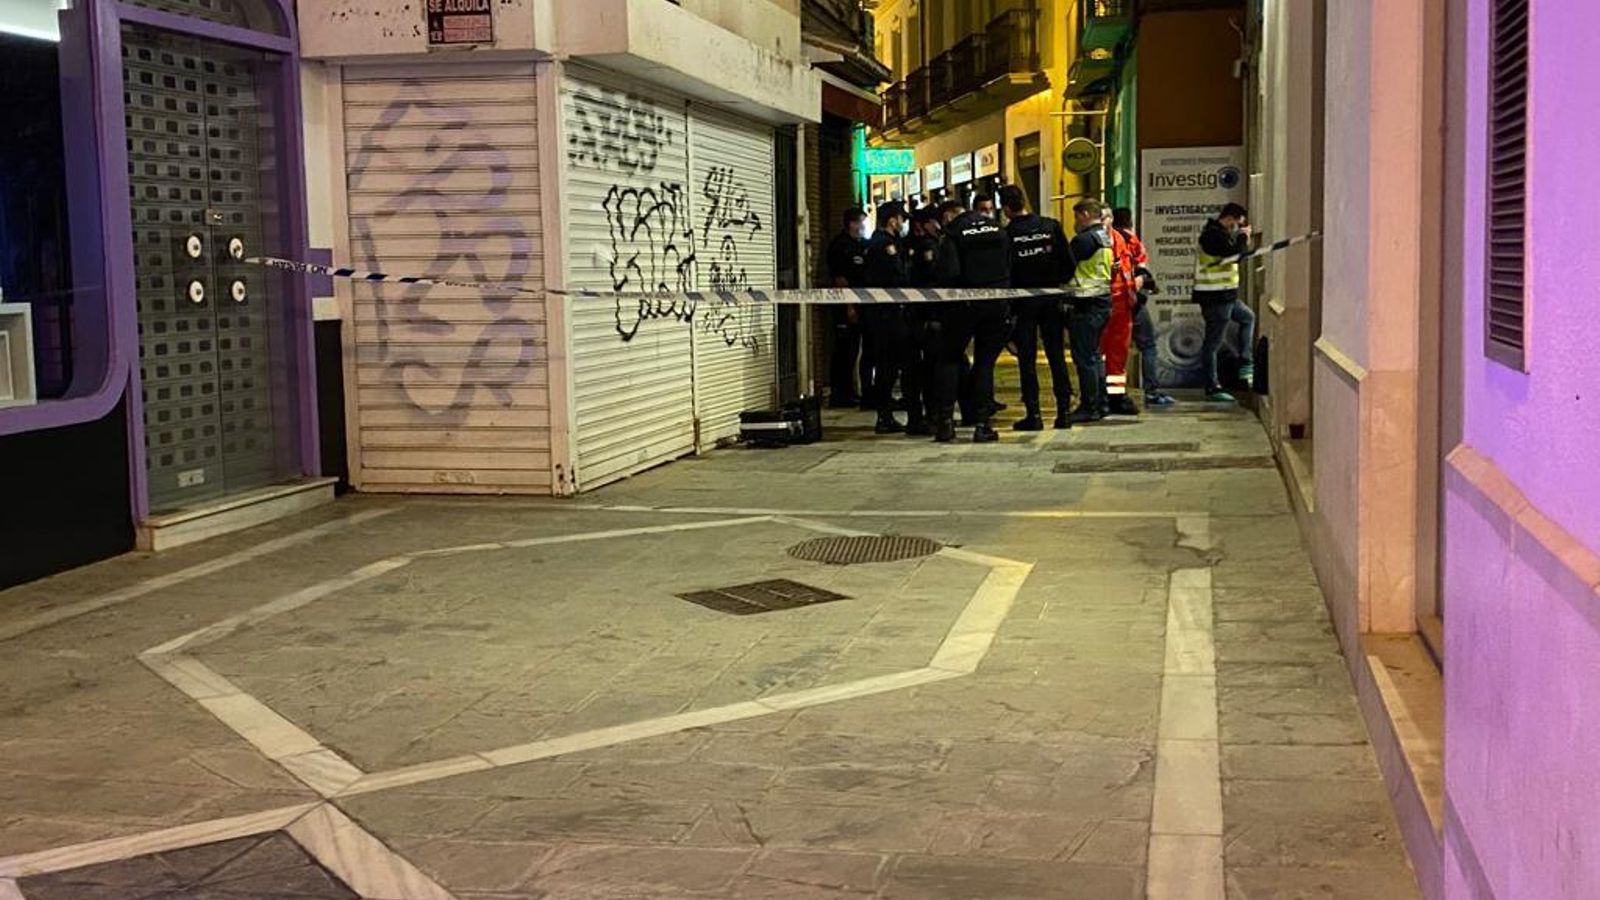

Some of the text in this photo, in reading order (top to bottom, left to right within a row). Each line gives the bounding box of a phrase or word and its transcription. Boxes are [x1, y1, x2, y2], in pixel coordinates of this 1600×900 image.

[429, 0, 490, 12] SE ALQUILA
[1155, 204, 1224, 215] INVESTIGACION
